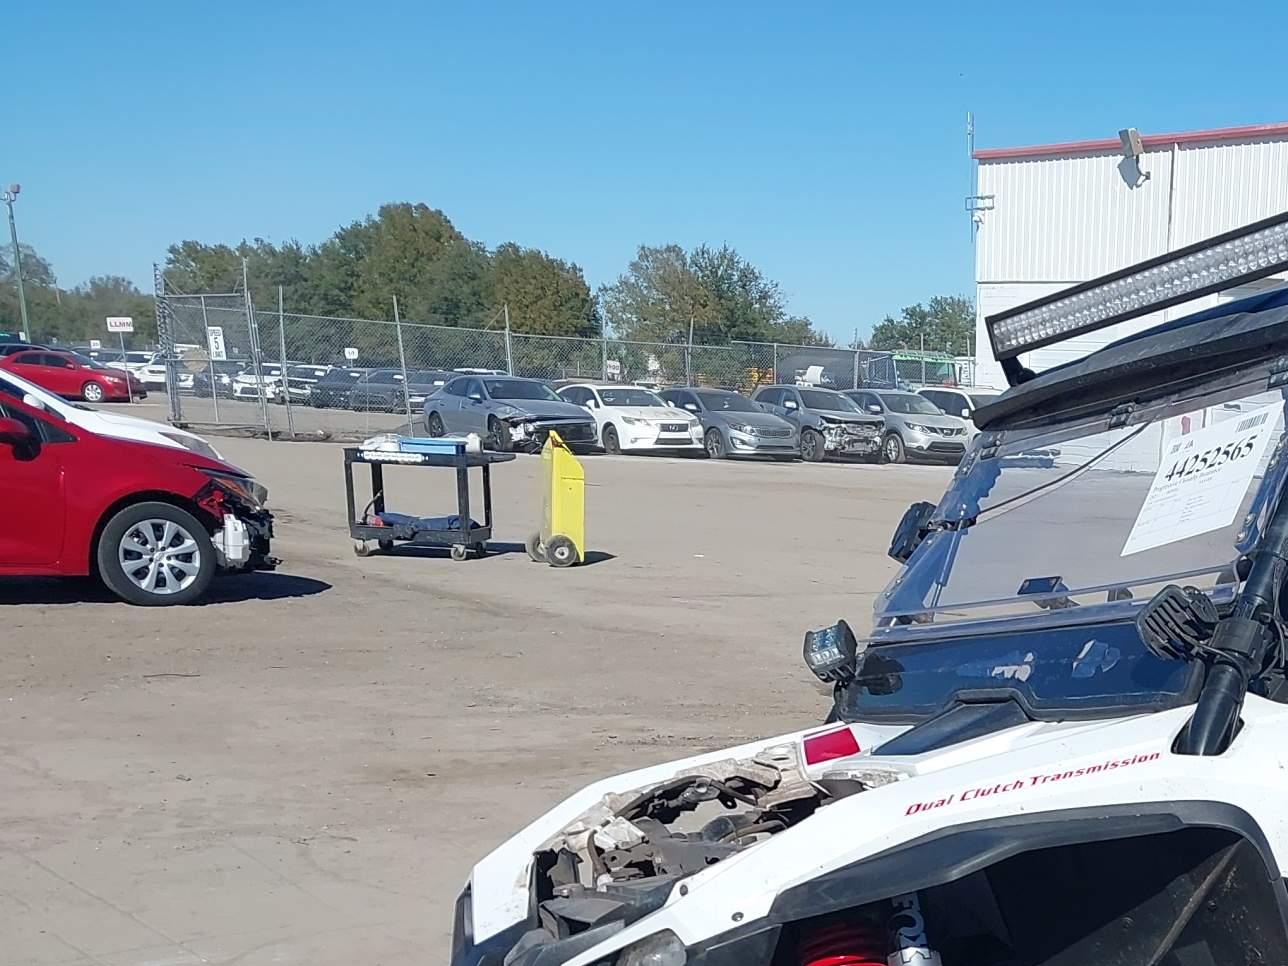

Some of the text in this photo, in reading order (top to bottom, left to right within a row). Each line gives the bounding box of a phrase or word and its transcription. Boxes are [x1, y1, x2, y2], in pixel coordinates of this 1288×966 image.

[213, 336, 220, 350] 5
[1164, 434, 1258, 482] 44252565
[903, 752, 1162, 816] Dual Clutch Transmission
